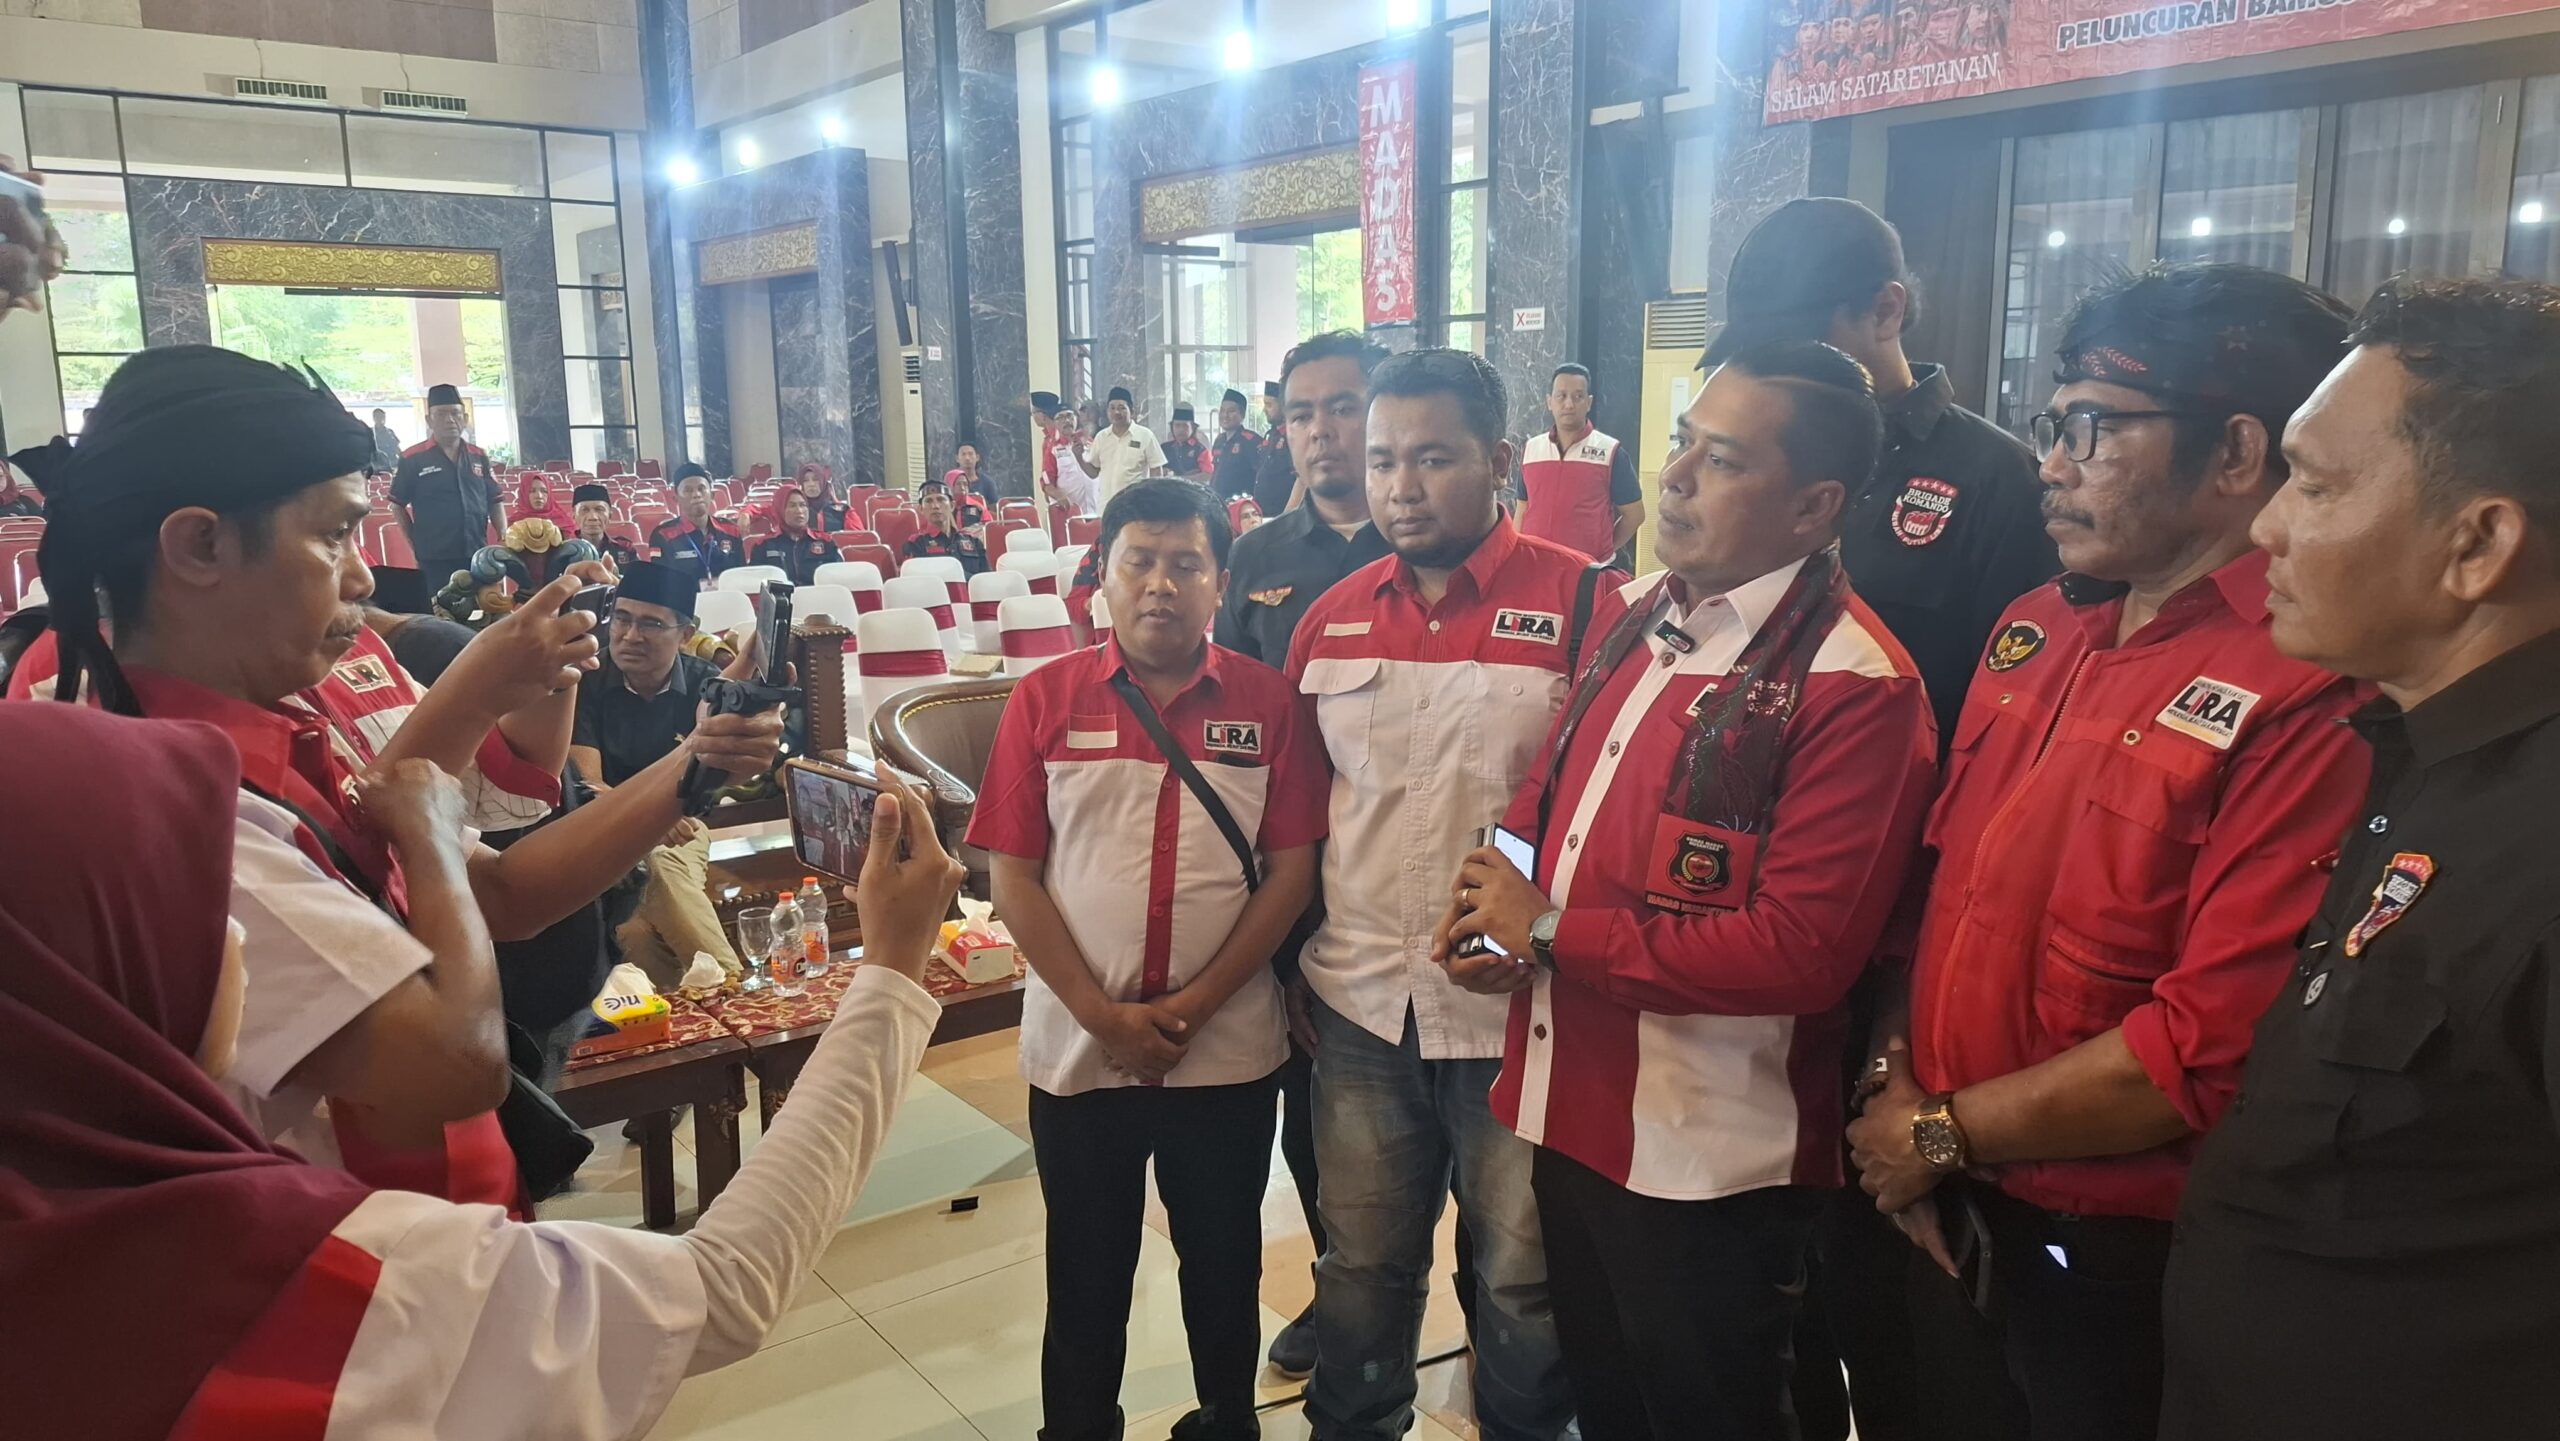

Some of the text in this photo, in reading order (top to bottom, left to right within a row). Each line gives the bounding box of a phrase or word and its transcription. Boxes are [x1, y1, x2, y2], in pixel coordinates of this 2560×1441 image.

[2057, 0, 2238, 50] PELUNCURAN
[1771, 52, 2000, 113] SALAM SATARETANAN
[1369, 80, 1403, 312] MADAS
[1902, 494, 1949, 513] KOMANDO
[1907, 487, 1952, 506] BRIGADE
[1496, 614, 1556, 638] LIRA
[2173, 684, 2242, 731] LIRA
[1206, 726, 1258, 747] LIRA
